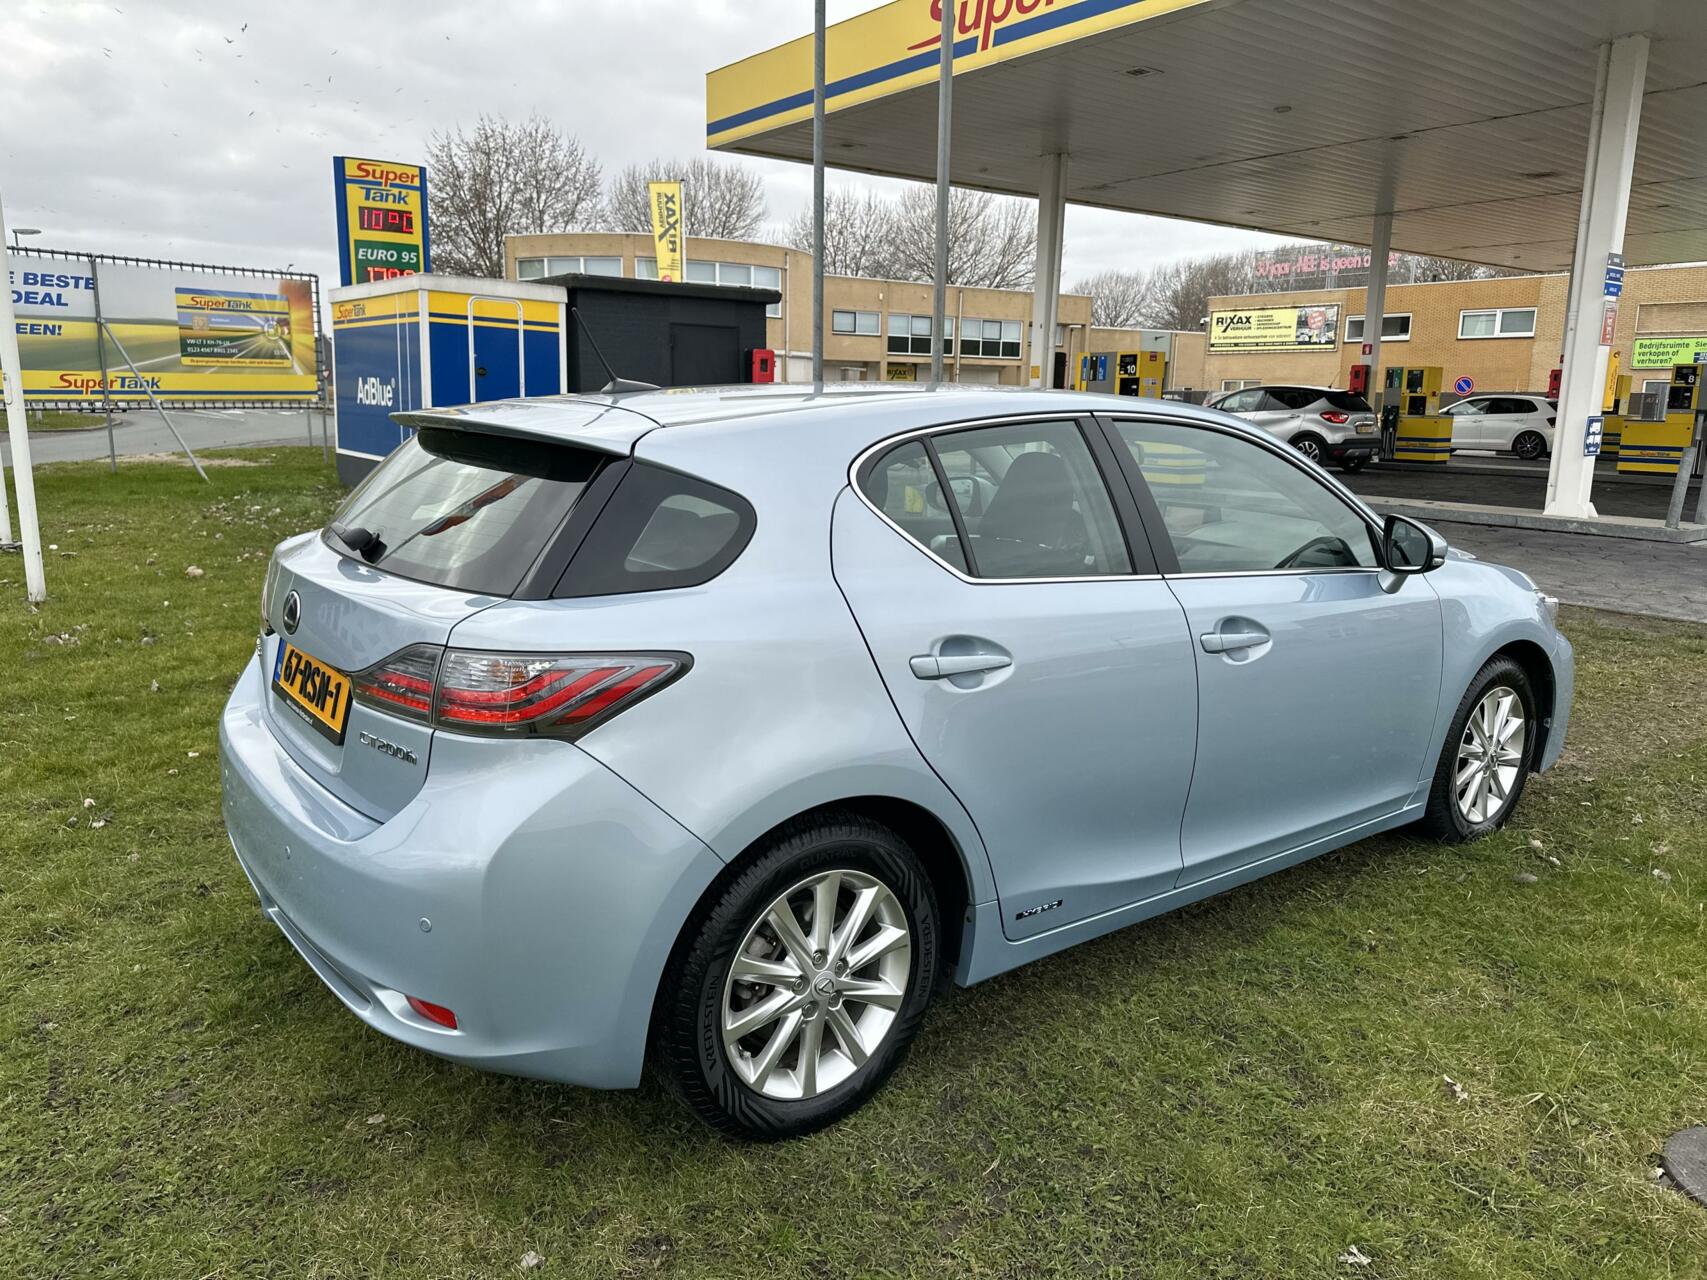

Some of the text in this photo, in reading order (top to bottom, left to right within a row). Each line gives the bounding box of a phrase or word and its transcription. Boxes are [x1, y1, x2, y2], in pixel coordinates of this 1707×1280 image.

[346, 162, 419, 187] Super
[358, 186, 409, 205] Tank
[358, 248, 418, 263] EURO 95
[23, 272, 95, 290] BESTE
[186, 296, 252, 310] SuperTank
[1216, 314, 1252, 333] RIXAX
[1639, 342, 1690, 350] Bedrijfsruimte
[1127, 365, 1136, 374] 10
[1688, 375, 1695, 383] 8
[50, 373, 161, 394] SuperTank
[283, 649, 342, 720] 67-RSN-1
[360, 731, 417, 765] CT200h
[704, 975, 720, 1071] VREDESTEIN
